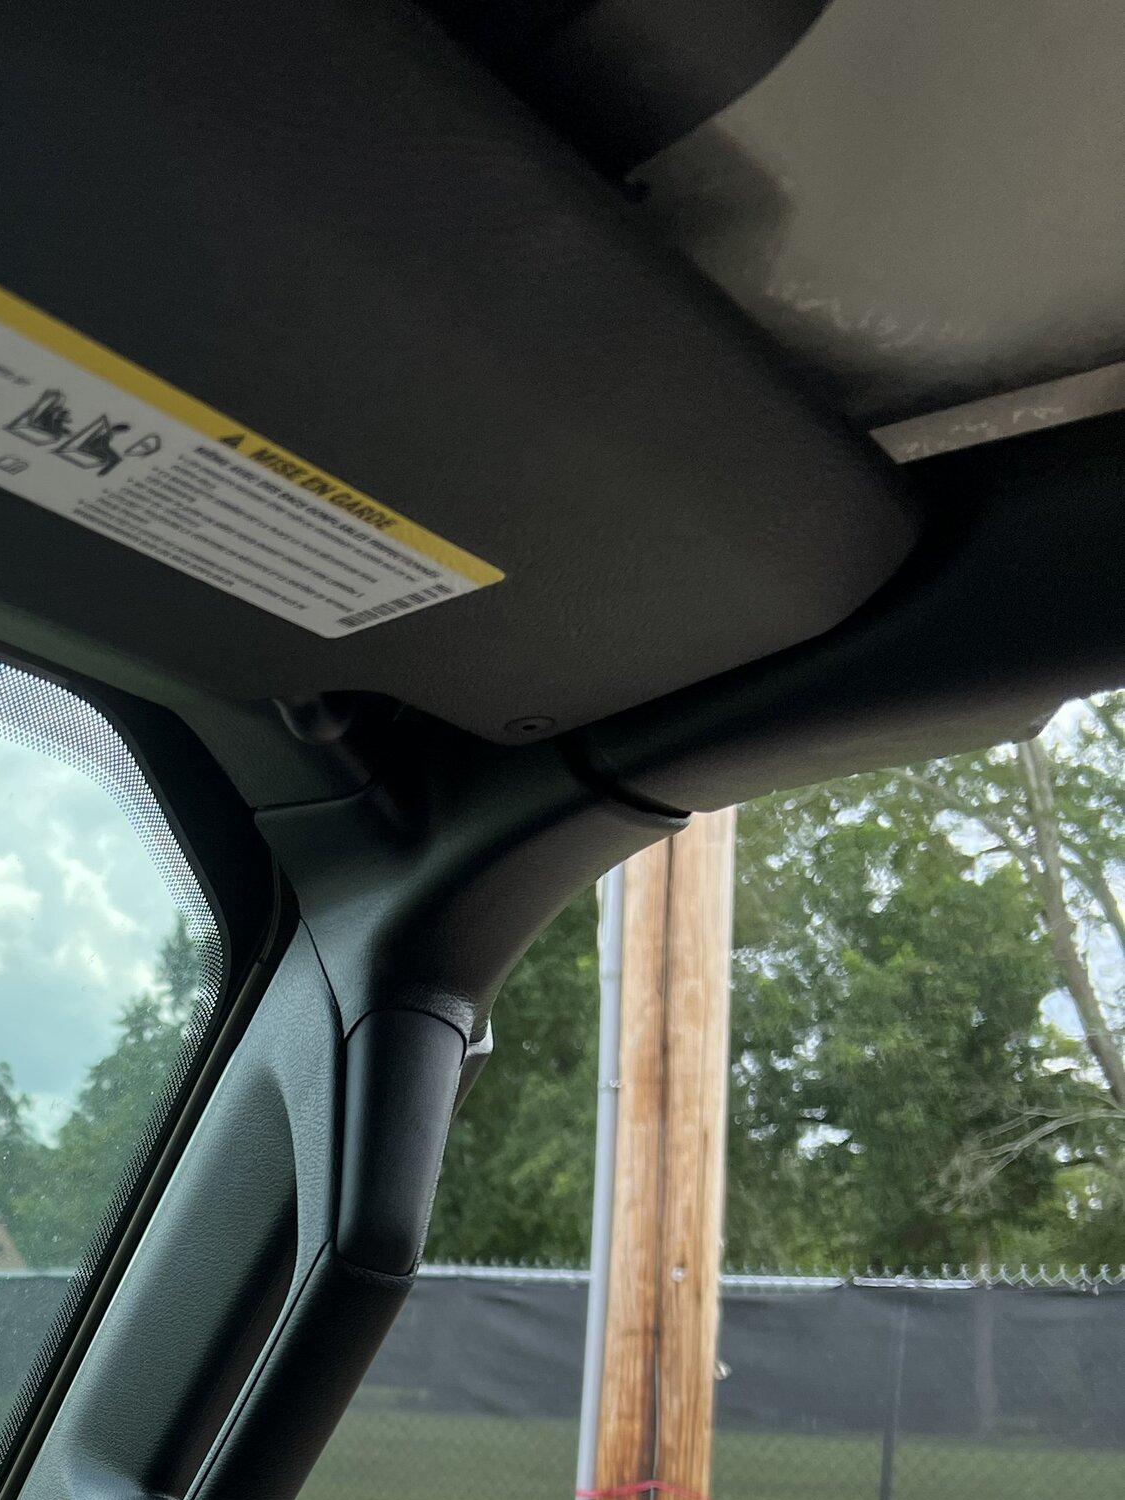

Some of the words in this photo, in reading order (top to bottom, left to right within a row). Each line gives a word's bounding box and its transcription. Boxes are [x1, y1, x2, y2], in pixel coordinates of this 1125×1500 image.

[249, 448, 308, 481] MISE
[299, 475, 339, 496] EN
[329, 491, 398, 531] GARDE
